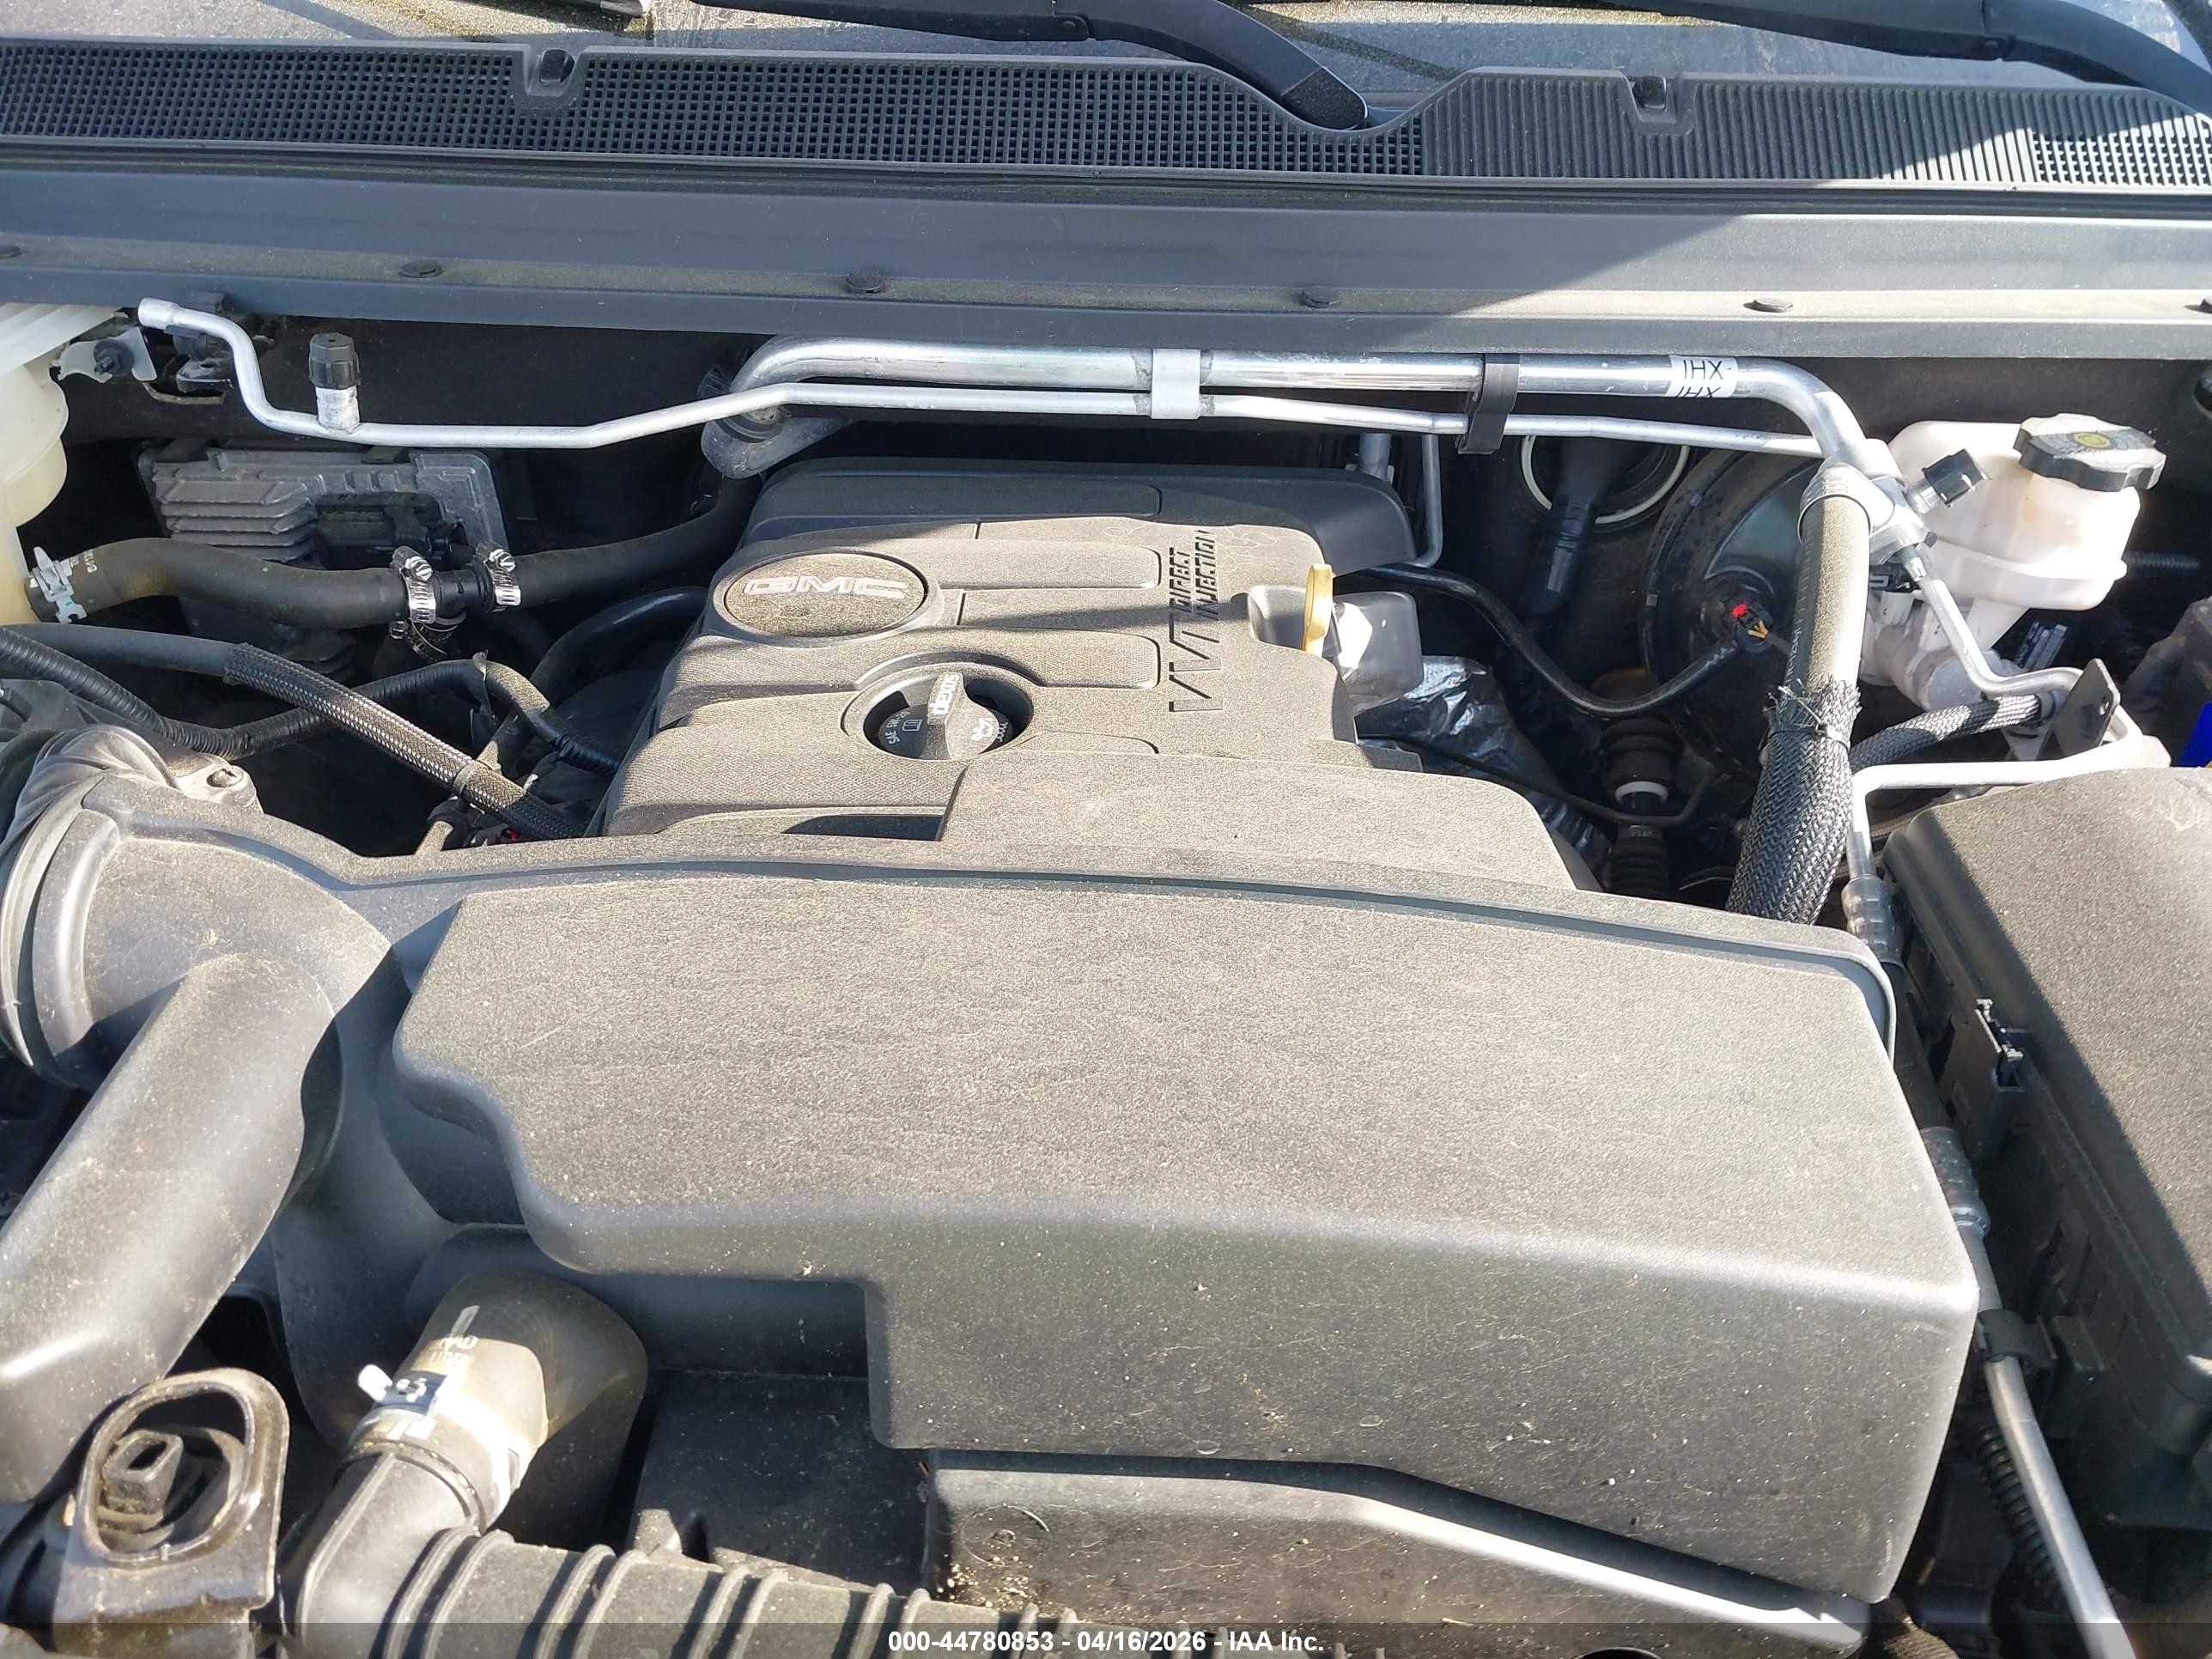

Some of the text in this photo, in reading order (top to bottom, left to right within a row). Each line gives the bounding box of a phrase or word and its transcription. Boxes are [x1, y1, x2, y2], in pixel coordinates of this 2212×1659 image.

[1683, 359, 1723, 380] IHX
[744, 575, 907, 599] GMC
[1169, 547, 1192, 613] DIRECT
[1194, 529, 1219, 621] INJECTION
[1169, 612, 1224, 713] VVT
[884, 710, 911, 745] SAE 5W-20
